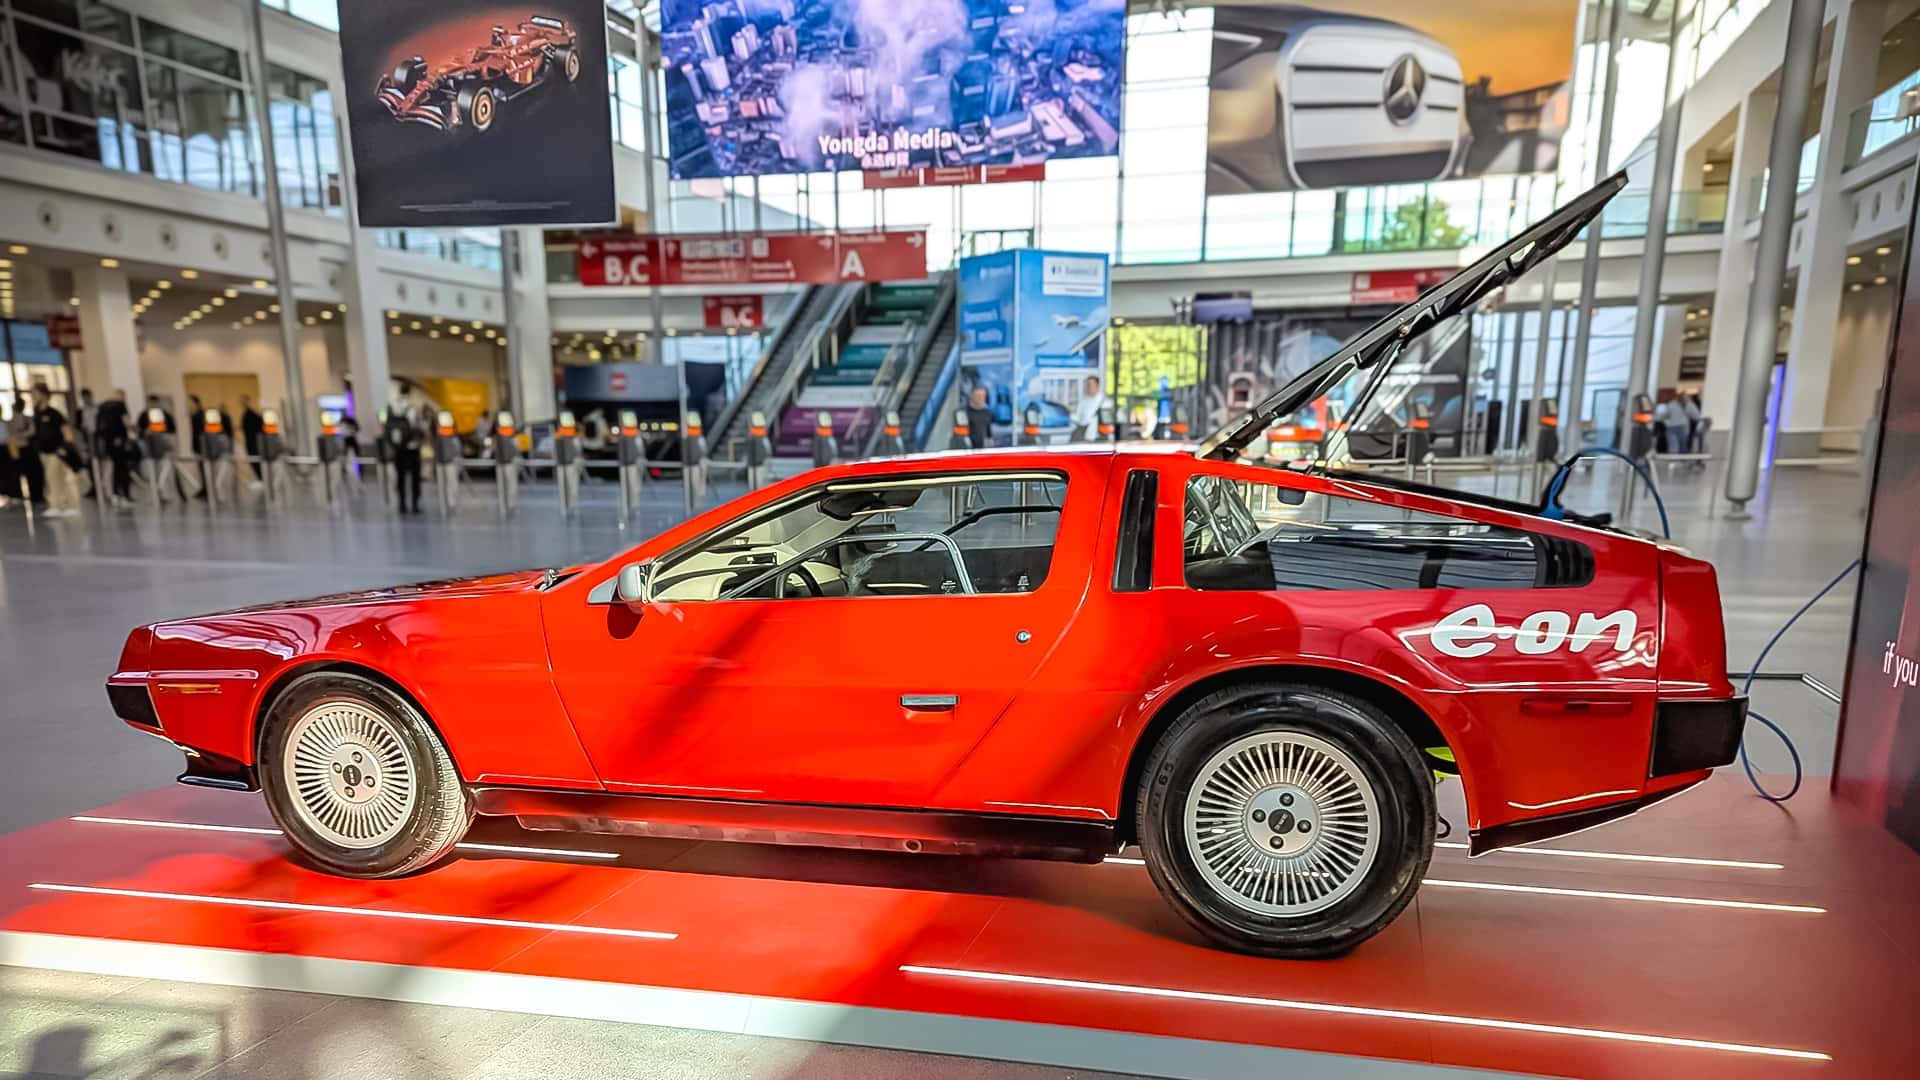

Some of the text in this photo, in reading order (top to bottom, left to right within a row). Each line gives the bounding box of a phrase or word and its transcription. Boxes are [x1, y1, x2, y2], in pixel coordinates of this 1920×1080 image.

[818, 128, 952, 158] Yongda Media
[604, 255, 650, 285] B,C
[841, 250, 865, 278] A
[1883, 640, 1919, 688] if you
